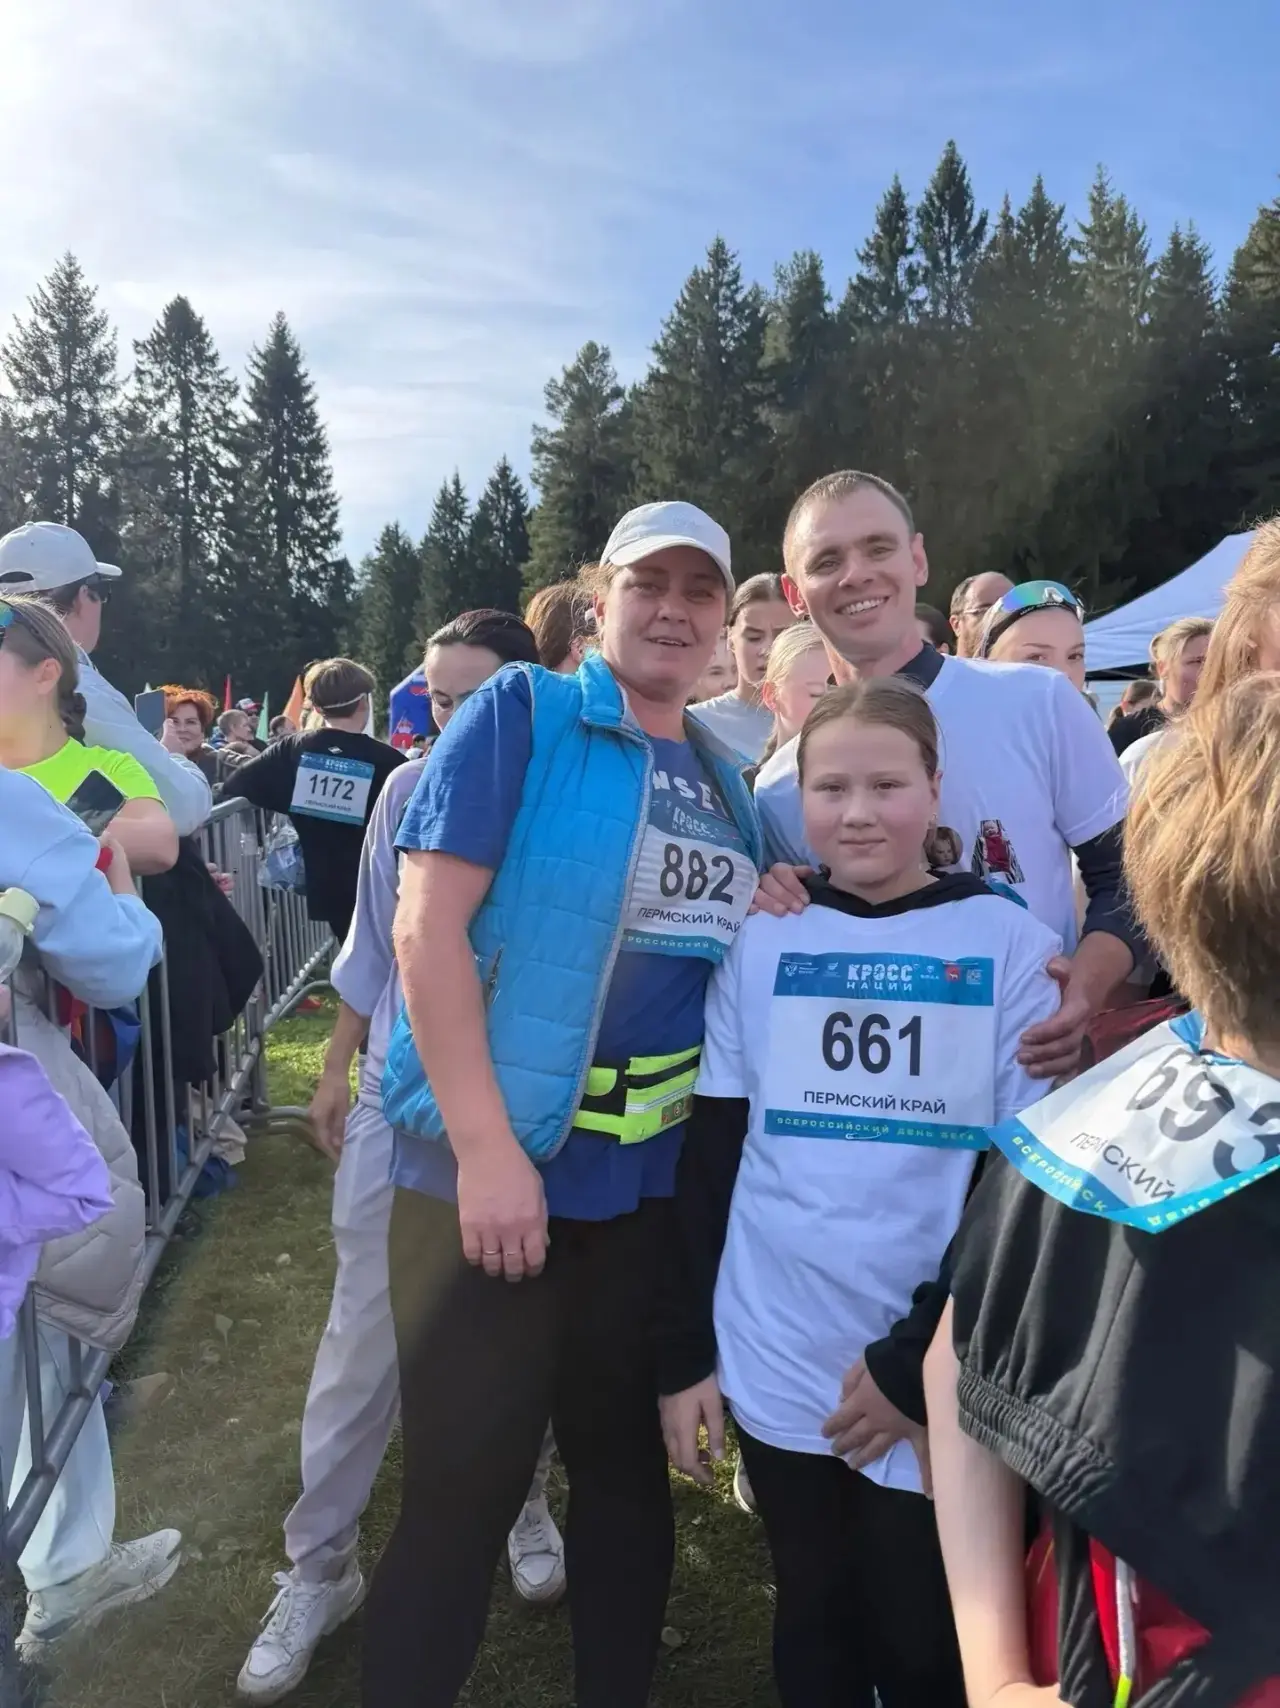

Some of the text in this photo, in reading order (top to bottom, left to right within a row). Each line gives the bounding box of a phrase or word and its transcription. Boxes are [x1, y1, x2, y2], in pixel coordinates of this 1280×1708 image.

[309, 773, 355, 801] 1172
[660, 843, 734, 906] 882
[637, 907, 714, 925] ПЕРМСКИЙ
[847, 963, 913, 982] КРОСС
[846, 981, 913, 992] НАЦИИ
[822, 1011, 922, 1077] 661
[803, 1090, 946, 1115] ПЕРМСКИЙ КРАЙ
[776, 1116, 890, 1134] ВСЕРОССИЙСКИЙ
